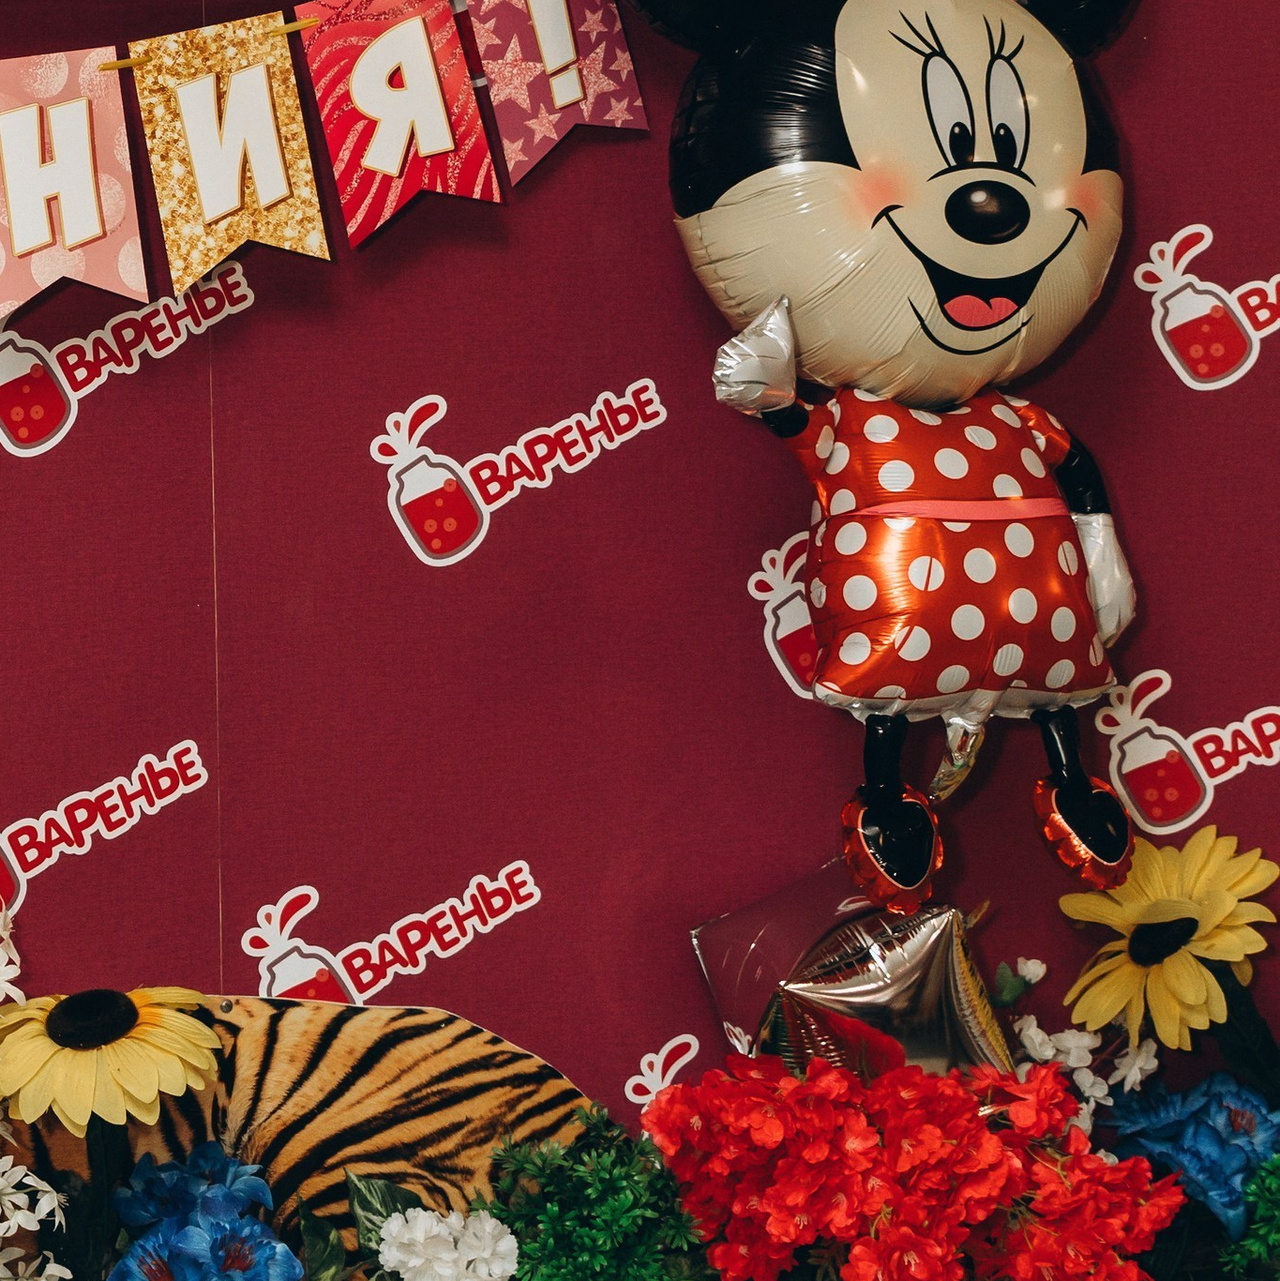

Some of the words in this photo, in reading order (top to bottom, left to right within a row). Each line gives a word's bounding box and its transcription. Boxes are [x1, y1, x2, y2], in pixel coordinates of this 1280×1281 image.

[56, 263, 250, 393] ВАРЕНЬЕ
[469, 384, 659, 505] ВАРЕНЬЕ
[8, 746, 201, 874] ВАРЕНЬЕ
[342, 865, 535, 994] ВАРЕНЬЕ
